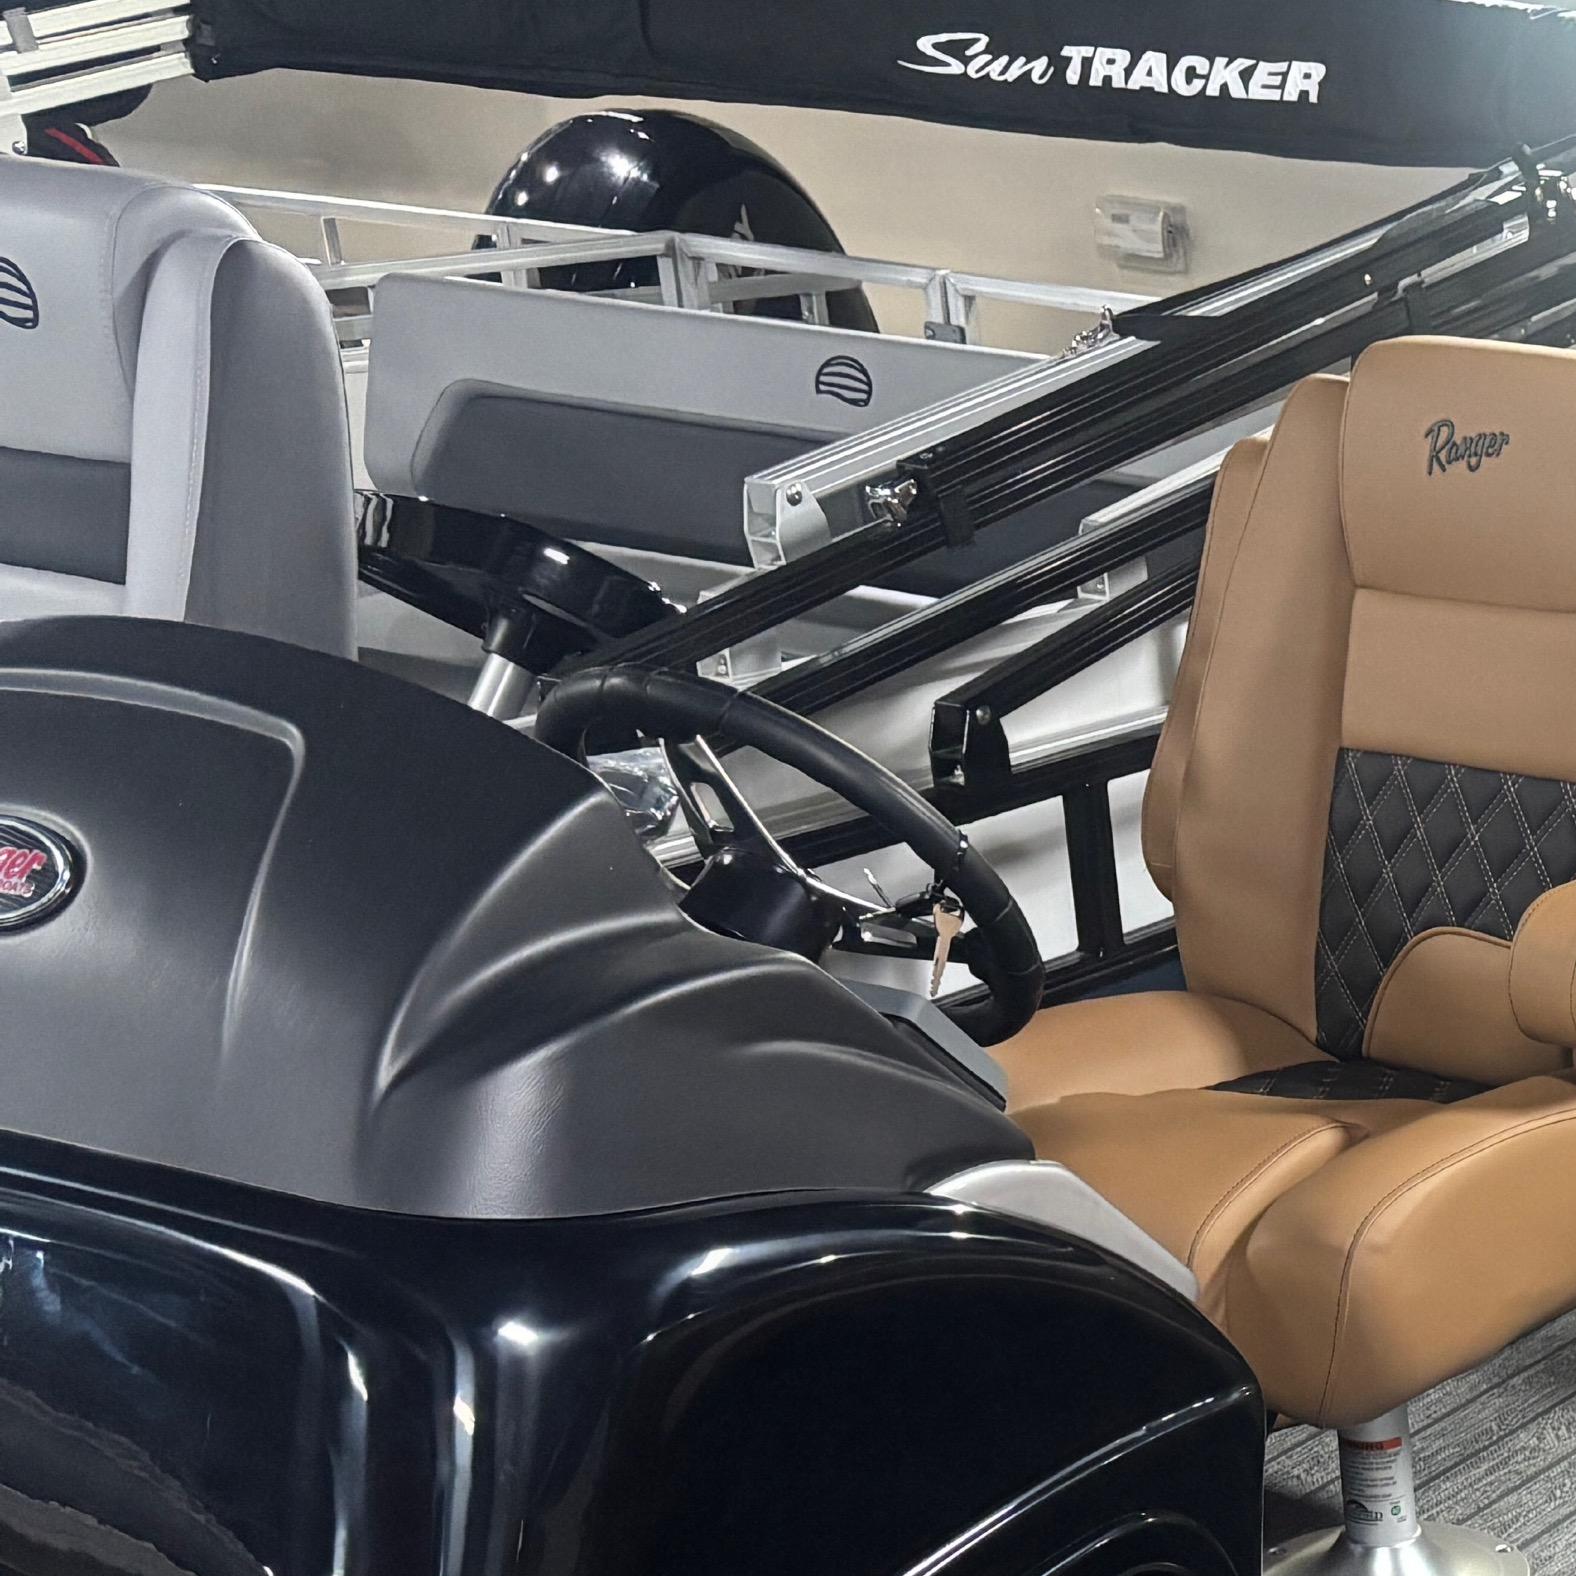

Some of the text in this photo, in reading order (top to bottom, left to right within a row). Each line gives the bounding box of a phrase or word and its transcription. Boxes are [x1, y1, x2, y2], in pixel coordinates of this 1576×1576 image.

[897, 32, 1327, 103] Sun TRACKER
[1424, 418, 1511, 476] Ranger
[0, 879, 33, 895] OATS
